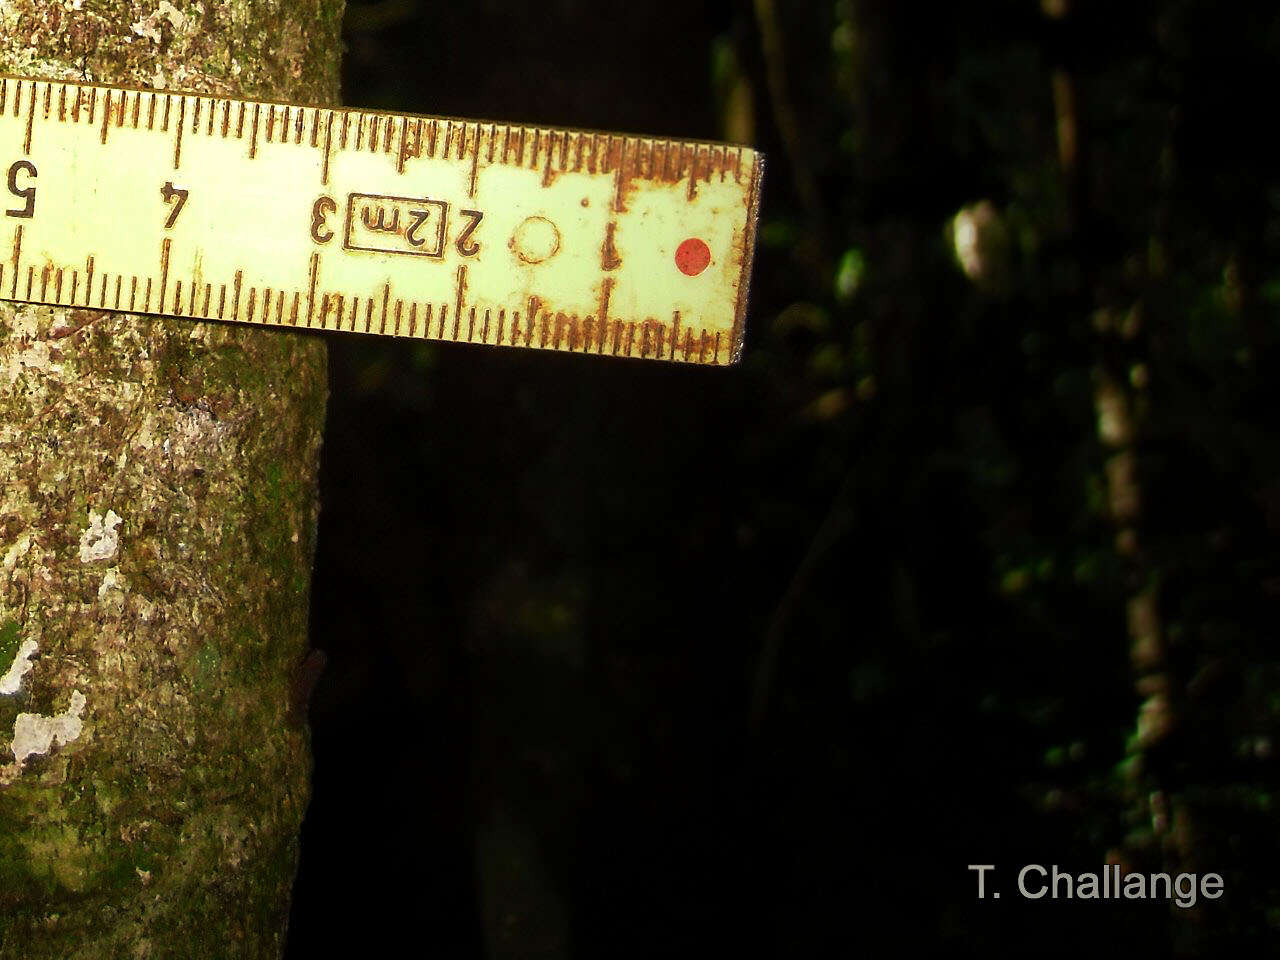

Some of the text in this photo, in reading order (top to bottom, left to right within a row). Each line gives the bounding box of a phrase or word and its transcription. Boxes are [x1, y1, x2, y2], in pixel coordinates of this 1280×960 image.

[5, 160, 38, 219] 5
[160, 181, 189, 229] 4
[311, 196, 336, 244] 3
[361, 205, 428, 248] 2m
[455, 209, 484, 257] 2
